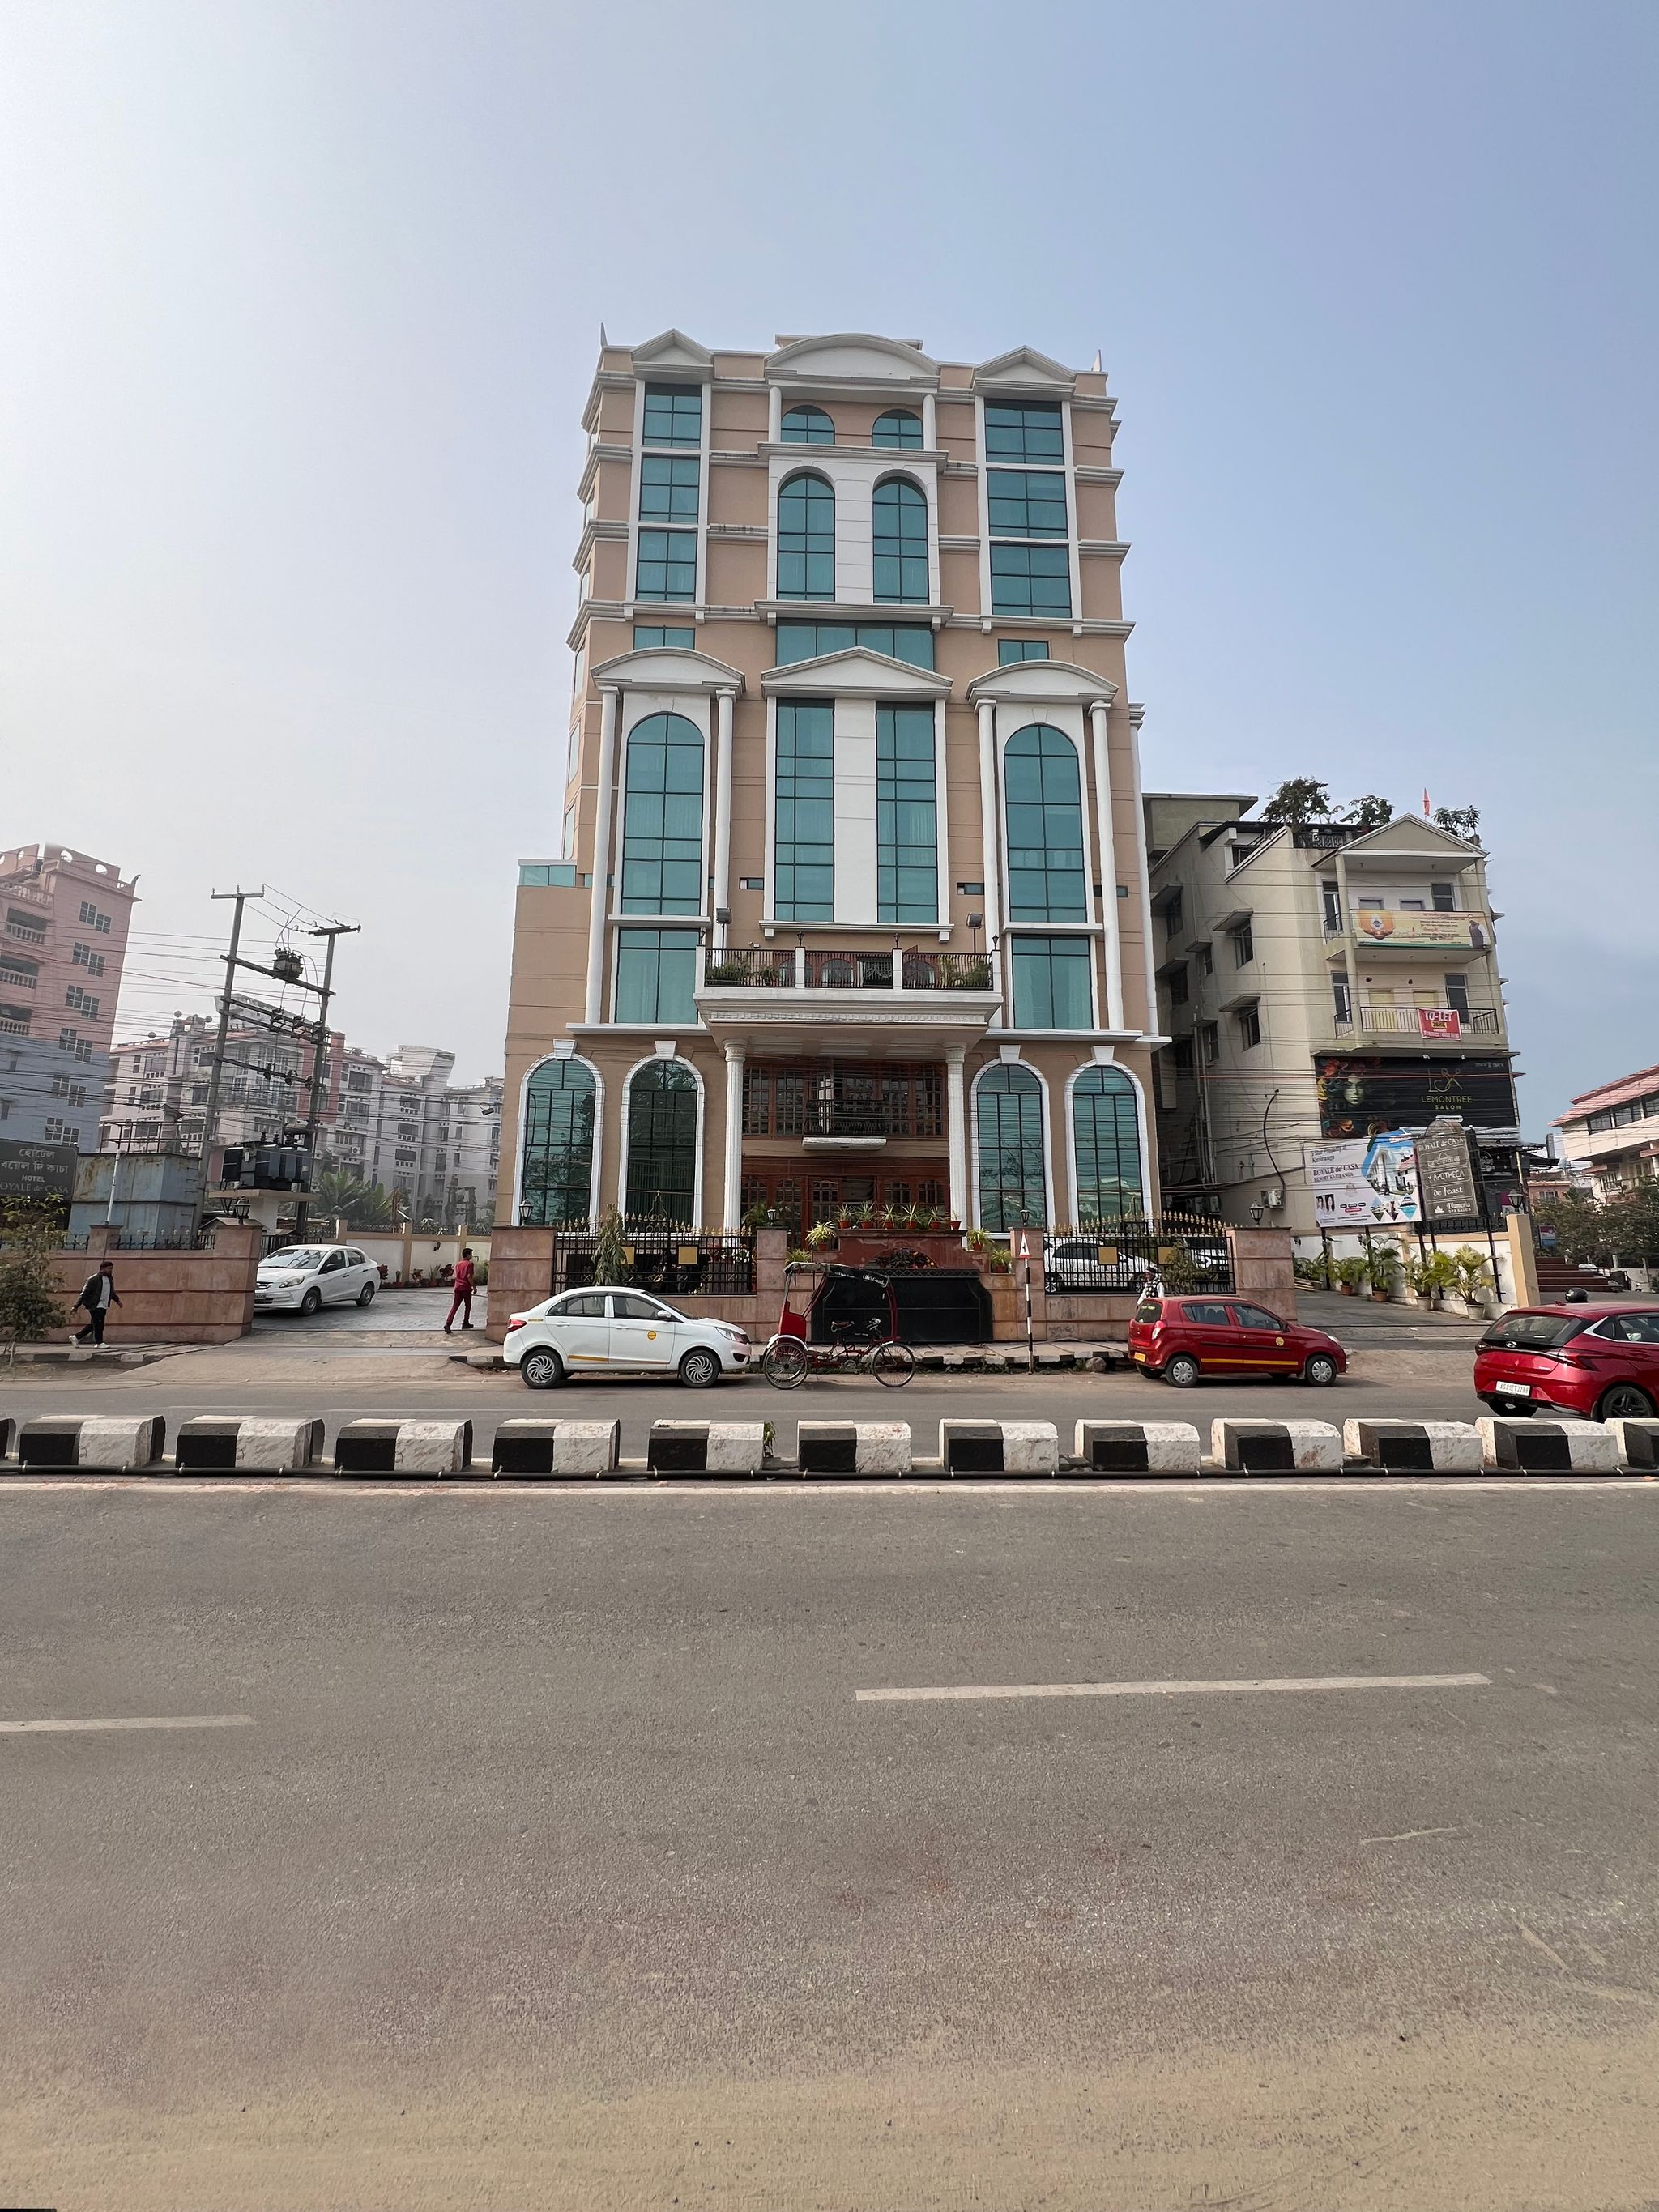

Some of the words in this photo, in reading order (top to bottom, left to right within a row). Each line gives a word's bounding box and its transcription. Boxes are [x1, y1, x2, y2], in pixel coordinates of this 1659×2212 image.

[1424, 1011, 1452, 1021] TO-LET
[1421, 1095, 1473, 1103] LEMONTREE
[1313, 1166, 1334, 1176] ROYALE
[1343, 1163, 1358, 1172] CASA
[22, 1174, 46, 1183] HOTEL
[0, 1182, 32, 1191] OYALE
[45, 1184, 69, 1193] CASA
